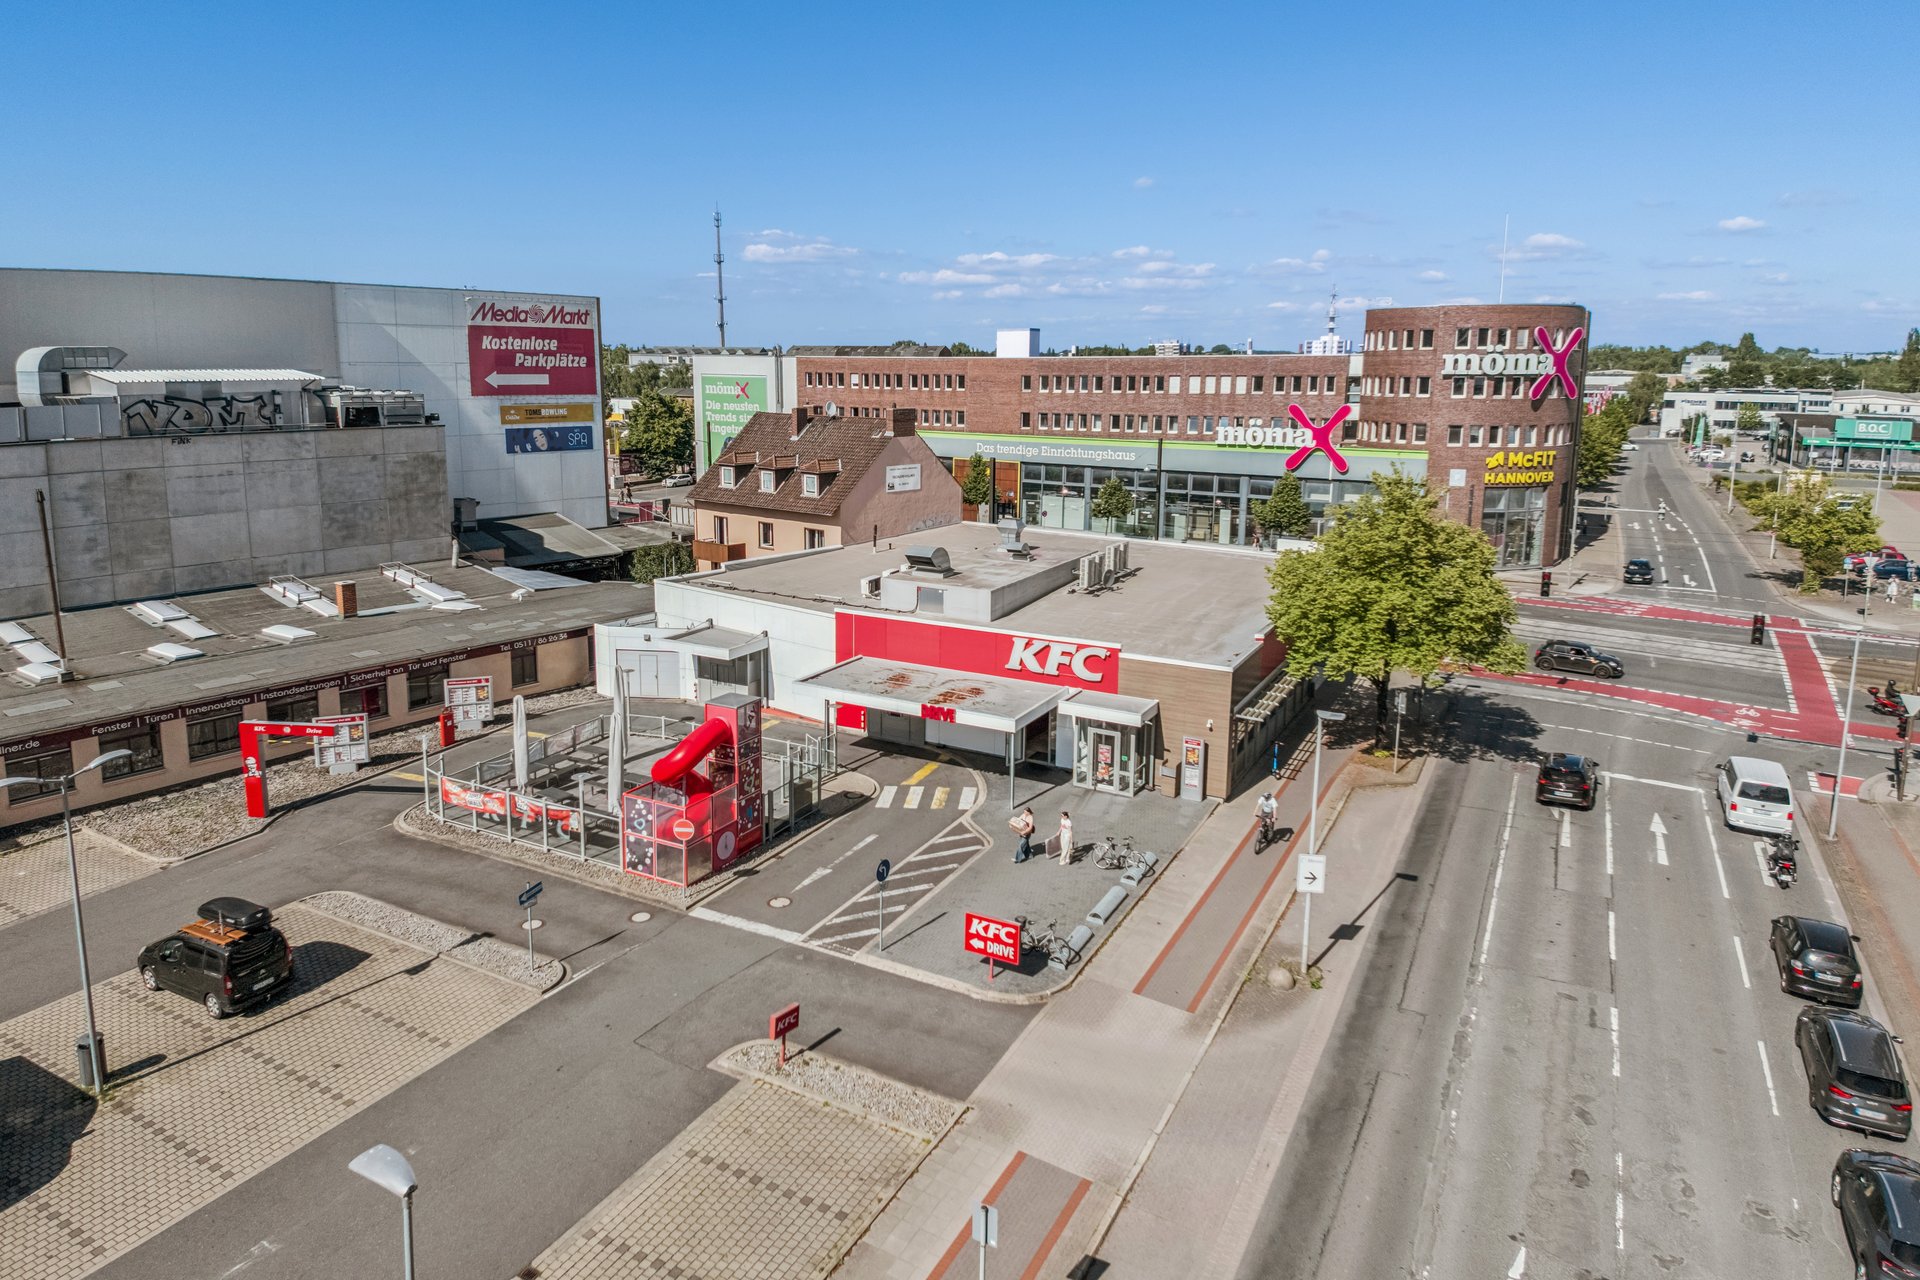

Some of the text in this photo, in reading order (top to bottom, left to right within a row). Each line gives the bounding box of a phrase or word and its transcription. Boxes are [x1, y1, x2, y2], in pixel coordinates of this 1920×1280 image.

[471, 302, 590, 325] Media Markt
[482, 336, 558, 351] Kostenlose
[515, 353, 587, 369] Parkplätze
[705, 400, 760, 411] Die neusten
[705, 411, 737, 422] Trends
[568, 432, 588, 446] SPA
[976, 443, 1136, 461] Das trendige Einrichtungshaus
[1508, 450, 1557, 467] McFIT
[1484, 471, 1554, 484] HANNOVER
[1005, 637, 1108, 682] KFC
[91, 720, 132, 736] Fenster
[144, 712, 174, 724] Türen
[186, 697, 250, 716] Innenausbau
[260, 679, 341, 701] Instandsetzungen
[350, 669, 391, 683] Sicherheit
[408, 663, 421, 671] Tür
[422, 660, 437, 668] und
[439, 654, 467, 664] Fenster
[500, 644, 512, 652] Tel.
[513, 639, 532, 649] 0511
[306, 727, 323, 735] Drive
[969, 917, 1017, 944] KFC
[986, 940, 1015, 960] DRIVE
[777, 1012, 798, 1032] KFC
